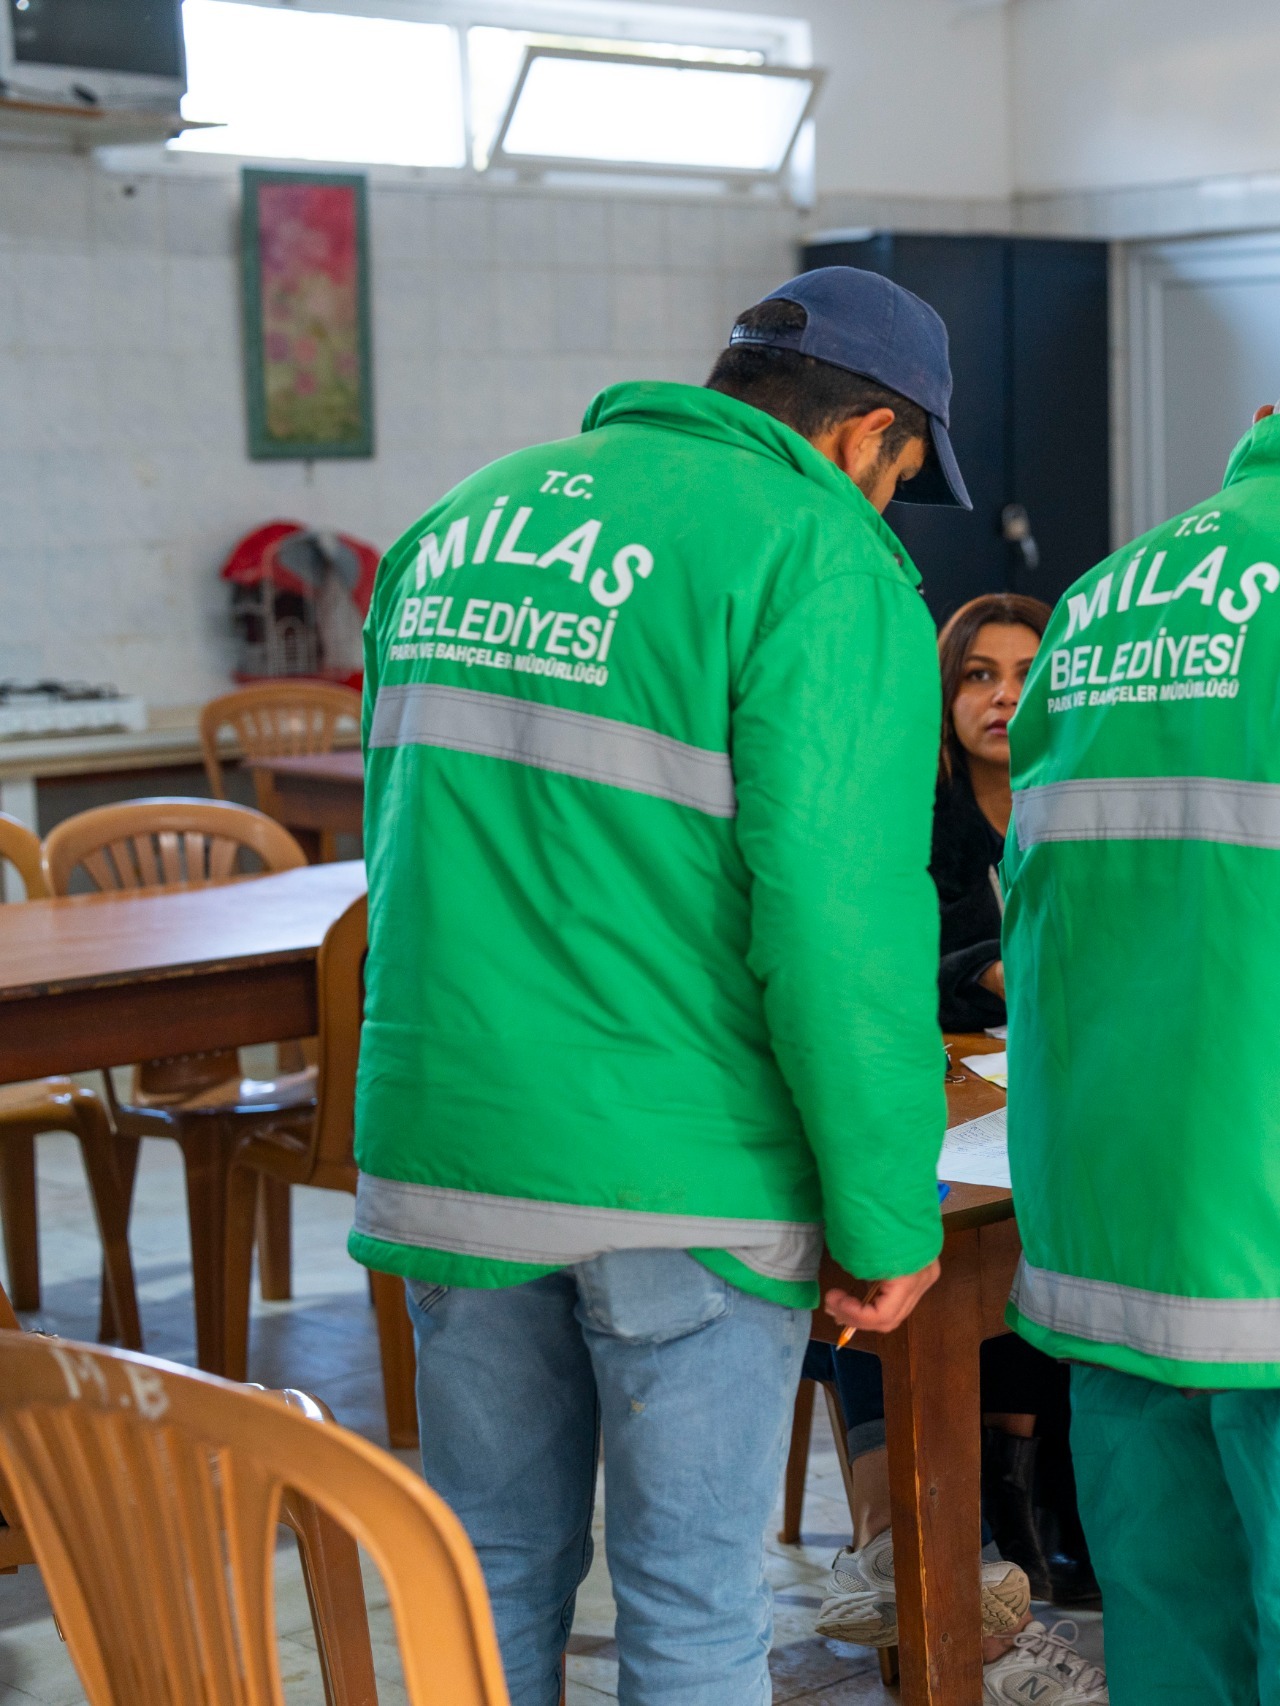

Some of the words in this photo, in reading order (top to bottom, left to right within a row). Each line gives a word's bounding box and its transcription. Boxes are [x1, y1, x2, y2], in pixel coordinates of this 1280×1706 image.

[539, 470, 594, 499] T.C.
[415, 495, 654, 607] MİLAS
[1174, 511, 1220, 537] T.C.
[1063, 546, 1280, 643] MİLAS
[398, 596, 618, 662] BELEDİYESİ
[390, 644, 418, 661] PARK
[420, 643, 434, 658] VE
[435, 644, 513, 668] BAHÇELER
[514, 653, 608, 686] MÜDÜRLÜĞÜ
[1051, 624, 1248, 691] BELEDİYESİ
[1047, 697, 1072, 714] PARK
[1073, 691, 1086, 707] VE
[1089, 685, 1157, 706] BAHÇELER
[1159, 677, 1239, 701] MÜDÜRLÜĞÜ
